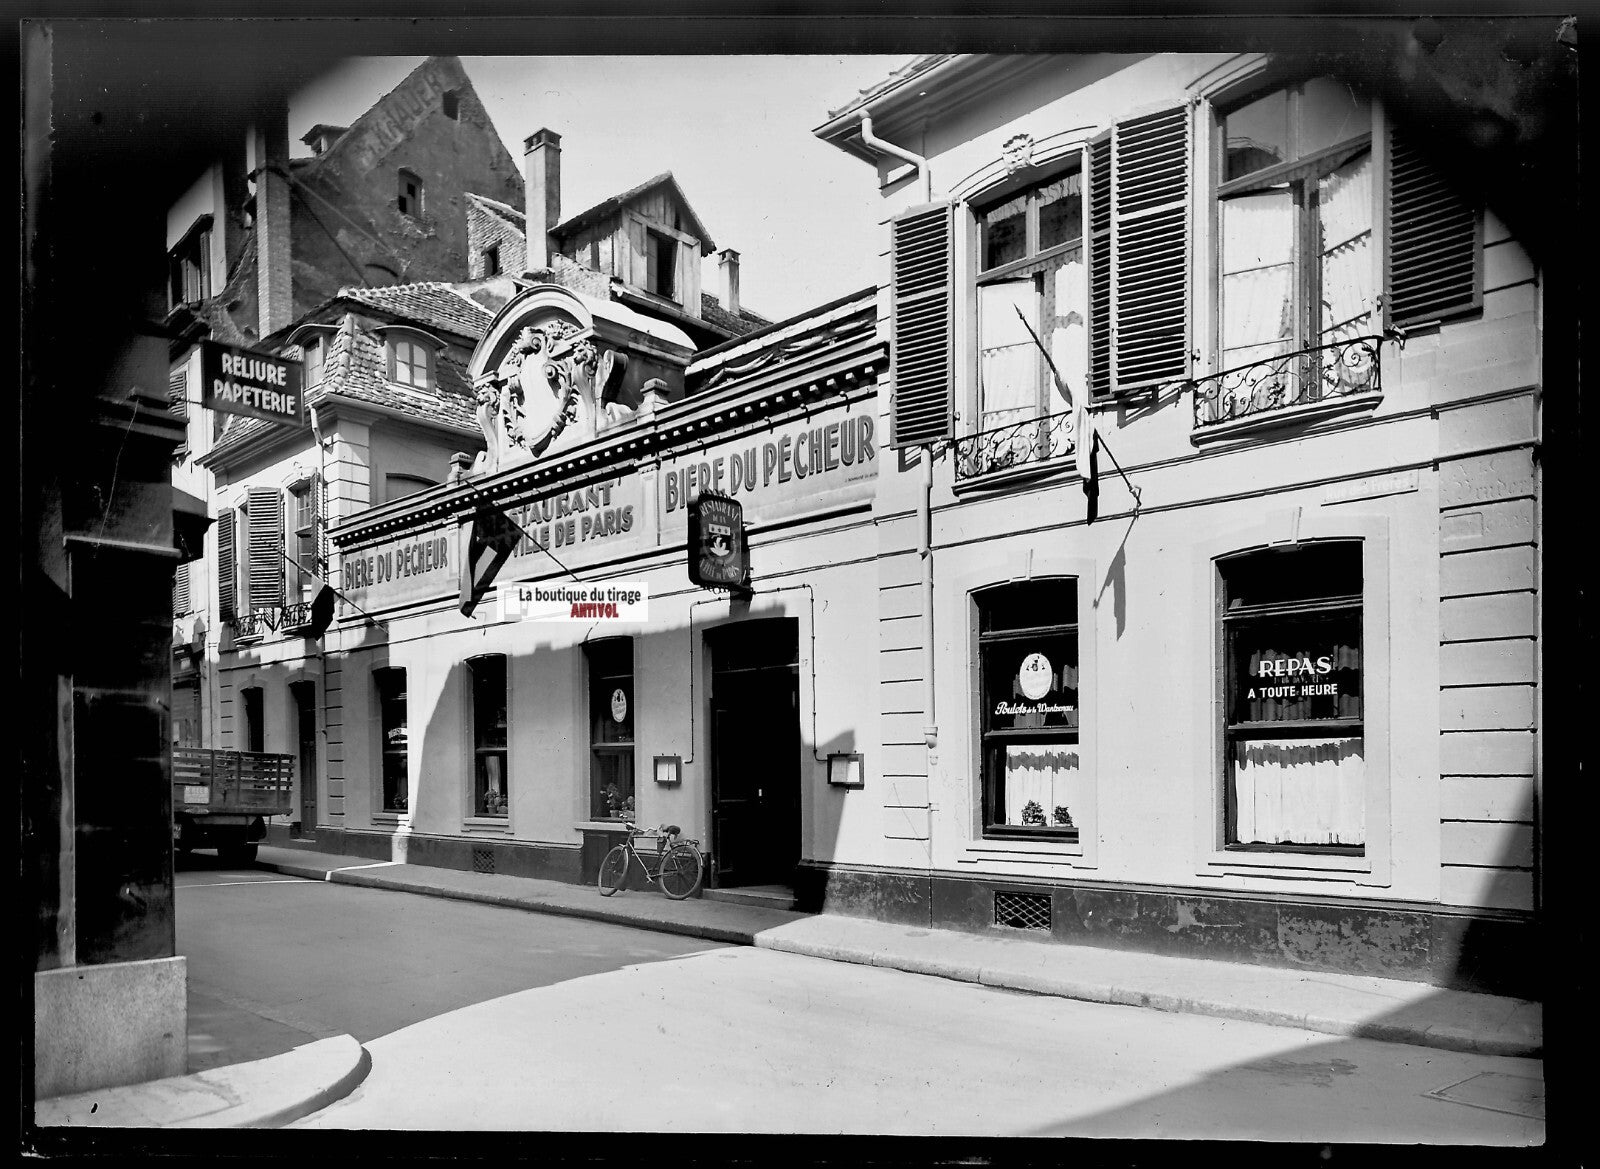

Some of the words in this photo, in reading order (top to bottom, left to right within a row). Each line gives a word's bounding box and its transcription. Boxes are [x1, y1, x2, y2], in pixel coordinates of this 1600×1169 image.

[222, 352, 287, 387] RELIURE
[213, 378, 296, 415] PAPETERIE
[730, 447, 757, 497] DU
[508, 481, 614, 528] STAURANT
[554, 519, 576, 549] DE
[581, 505, 634, 542] PARIS
[377, 551, 393, 584] DU
[1258, 655, 1332, 678] REPAS
[1247, 687, 1256, 699] A
[1259, 686, 1296, 698] TOUTE
[1301, 683, 1338, 696] HEURE
